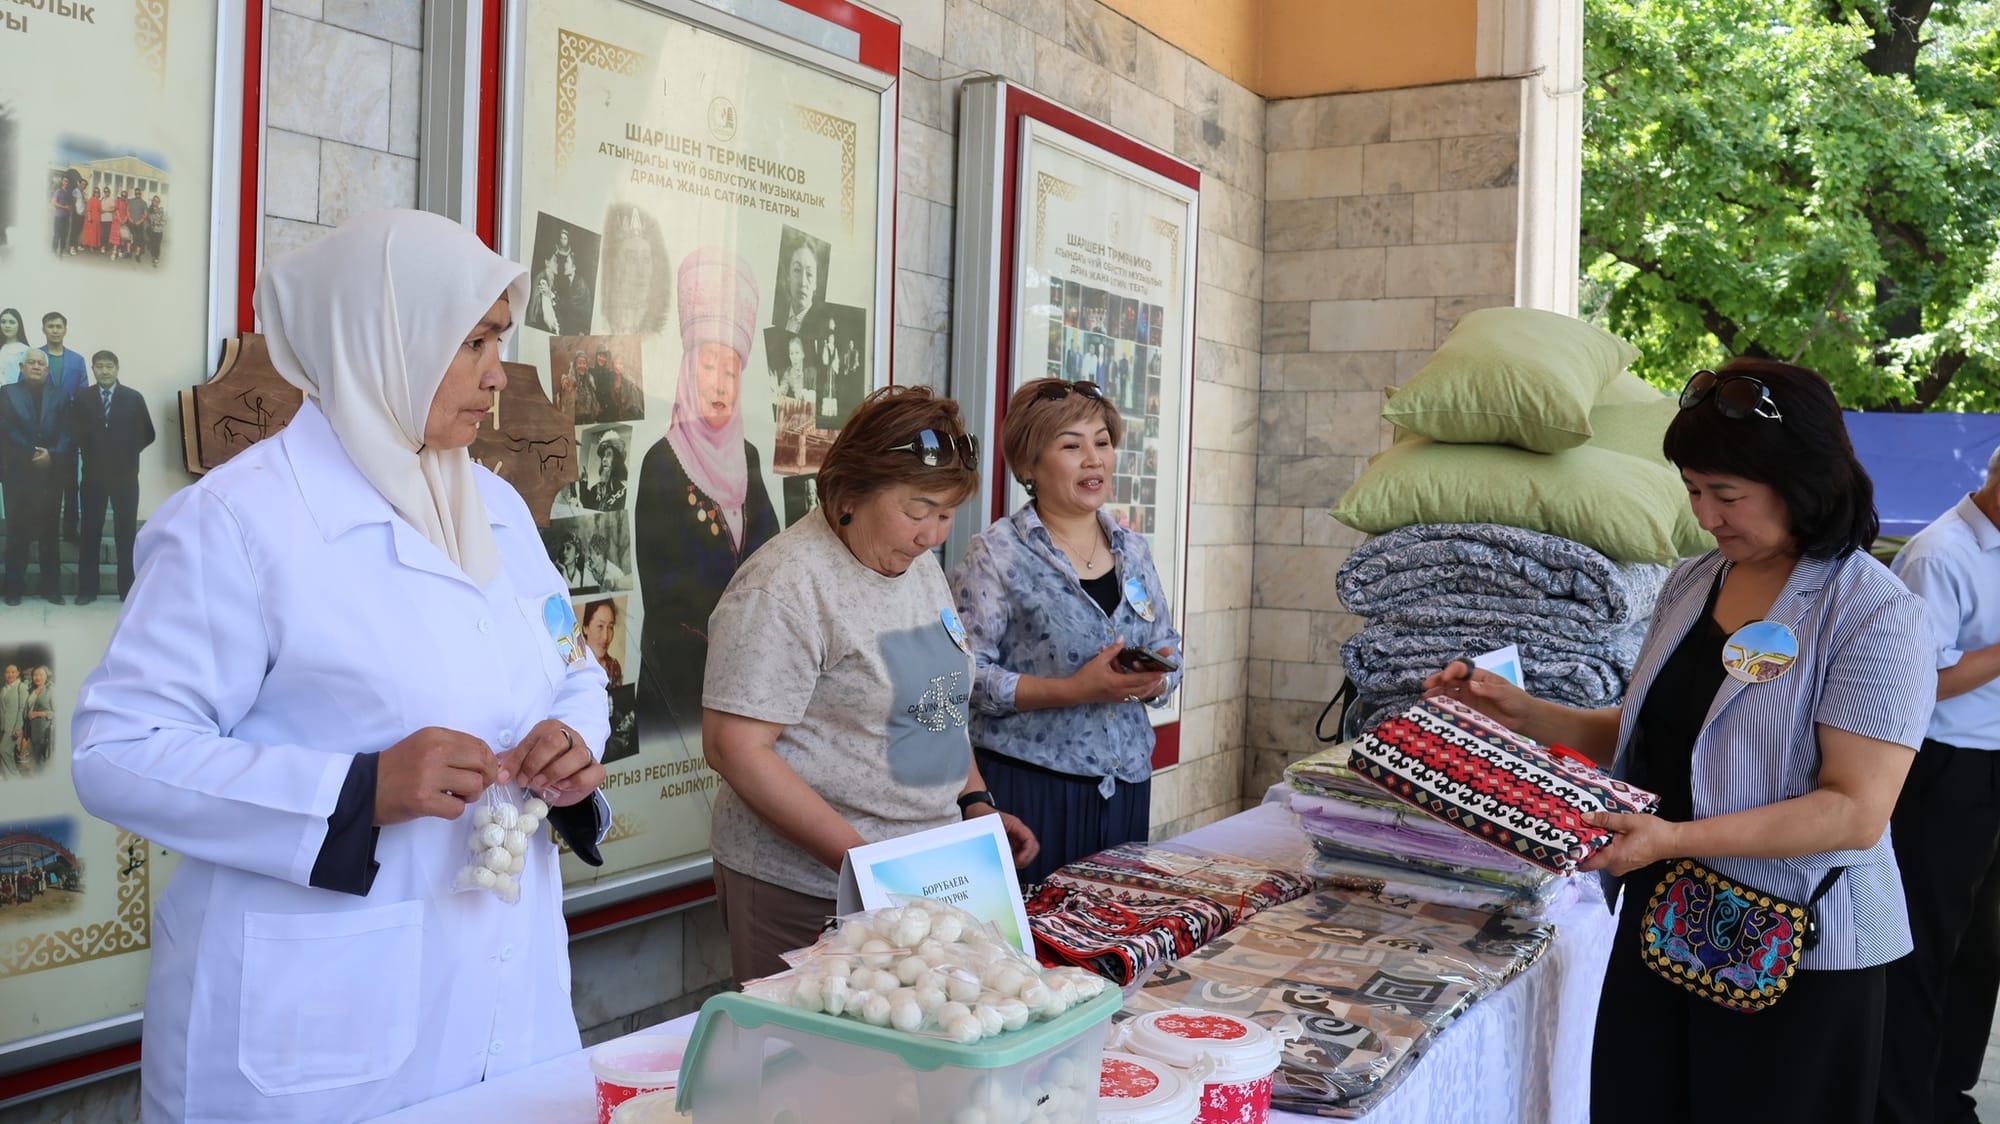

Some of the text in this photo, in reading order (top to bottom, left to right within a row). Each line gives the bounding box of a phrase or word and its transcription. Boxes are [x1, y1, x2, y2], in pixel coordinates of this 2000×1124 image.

[5, 0, 95, 24] ЛЫК
[625, 122, 806, 185] ШАРШЕН ТЕРМЕЧИКОВ
[598, 141, 669, 170] АТЫНДАГЫ
[699, 167, 757, 192] ОБЛУСТУК
[759, 181, 825, 208] МУЗЫКАЛЫК
[630, 168, 800, 218] ДРАМА ЖАНА САТИРА ТЕАТРЫ
[1067, 233, 1105, 256] ШАРШЕН
[599, 769, 641, 791] ЫРГЫЗ
[644, 757, 708, 781] РЕСПУБЛИ
[922, 875, 969, 897] БОРУБАЕВА
